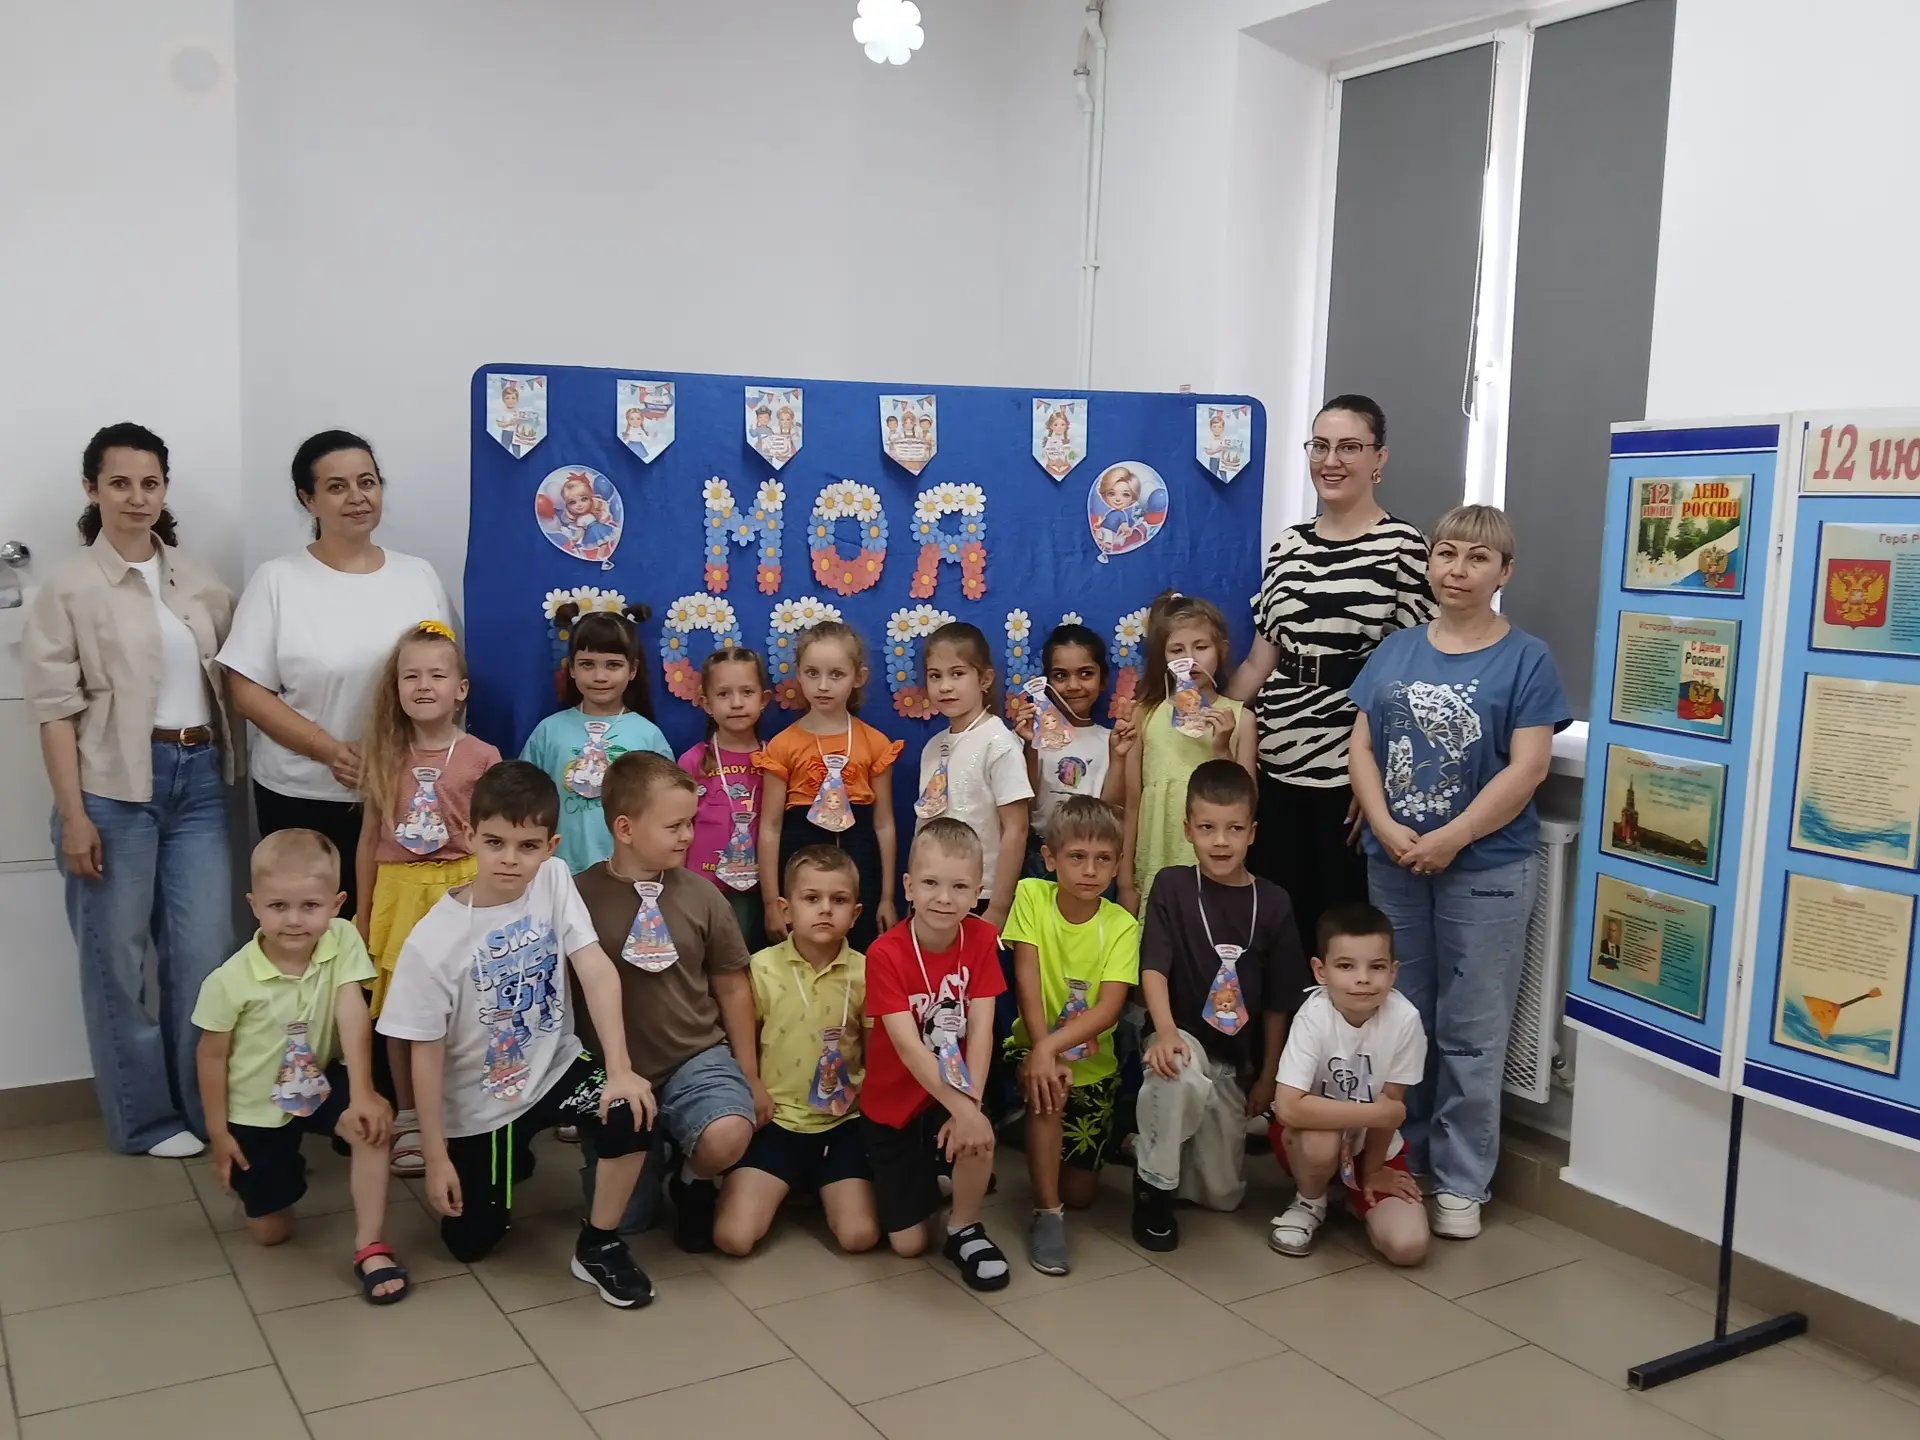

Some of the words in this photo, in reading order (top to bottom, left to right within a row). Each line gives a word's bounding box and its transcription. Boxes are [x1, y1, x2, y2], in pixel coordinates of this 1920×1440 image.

[1812, 424, 1858, 481] 12
[1649, 483, 1670, 504] 12
[1691, 483, 1729, 500] ДЕНЬ
[1681, 501, 1738, 518] РОССИИ
[702, 476, 987, 600] МОЯ
[1879, 533, 1908, 545] Герб
[1685, 652, 1725, 668] России!
